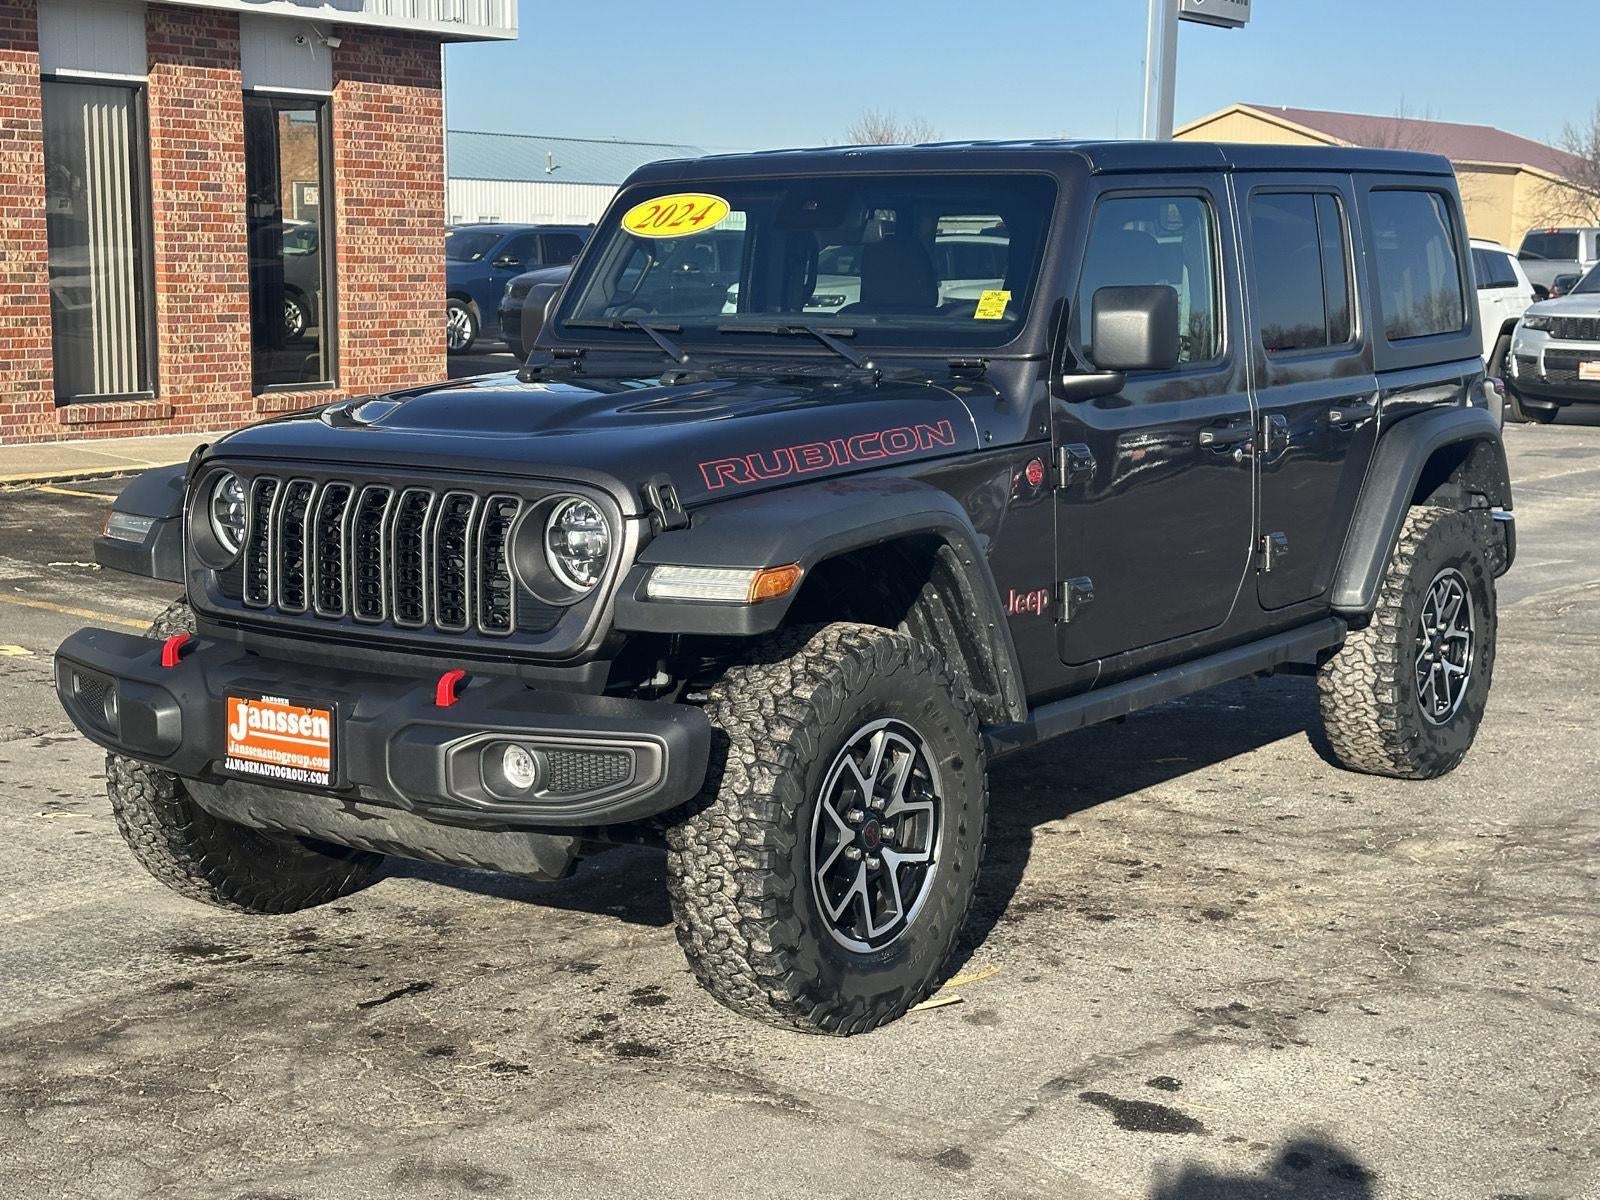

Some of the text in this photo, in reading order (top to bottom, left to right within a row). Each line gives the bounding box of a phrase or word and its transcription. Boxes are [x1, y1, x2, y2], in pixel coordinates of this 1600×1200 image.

[633, 201, 718, 229] 2024
[699, 419, 957, 491] RUBICON
[1004, 588, 1050, 616] Jeep
[230, 703, 330, 741] Janssen
[224, 757, 330, 786] JANSSENAUTOGROUP.COM
